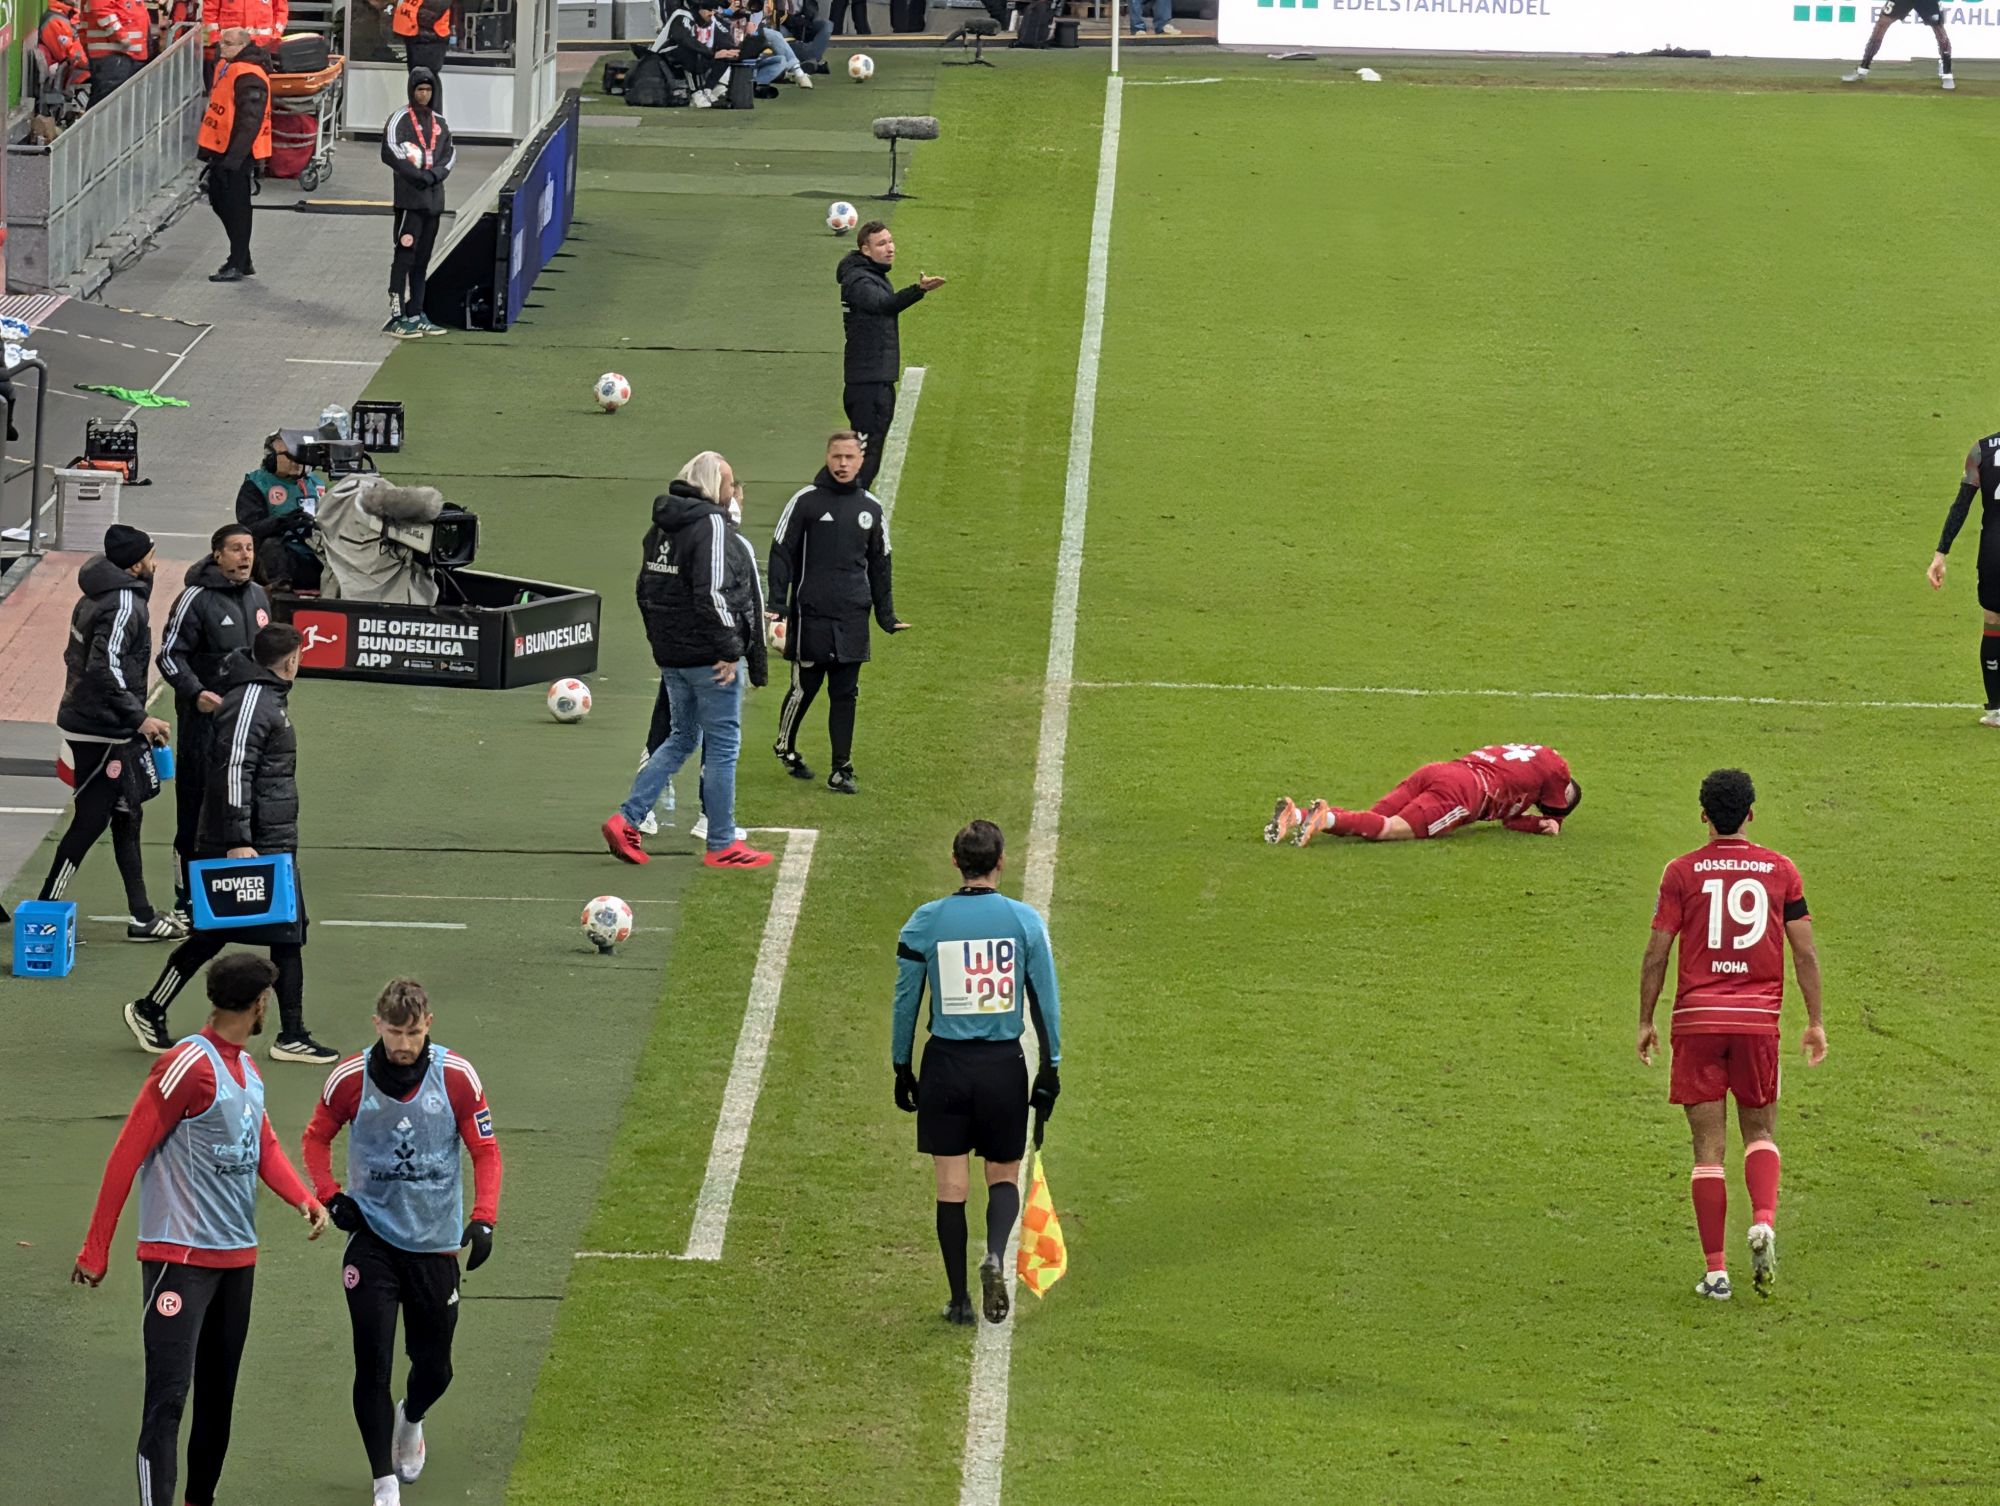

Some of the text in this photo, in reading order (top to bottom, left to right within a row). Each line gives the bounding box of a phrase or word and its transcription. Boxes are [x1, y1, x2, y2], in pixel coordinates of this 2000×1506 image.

[358, 618, 480, 640] DIE OFFIZIELLE
[357, 635, 465, 656] BUNDESLIGA
[525, 622, 594, 655] BUNDESLIGA
[355, 652, 392, 668] APP
[1693, 858, 1776, 874] DÜSSELDORF
[211, 875, 265, 893] POWER
[236, 888, 266, 903] ADE
[1701, 878, 1769, 950] 19
[1711, 960, 1749, 974] IYOHA
